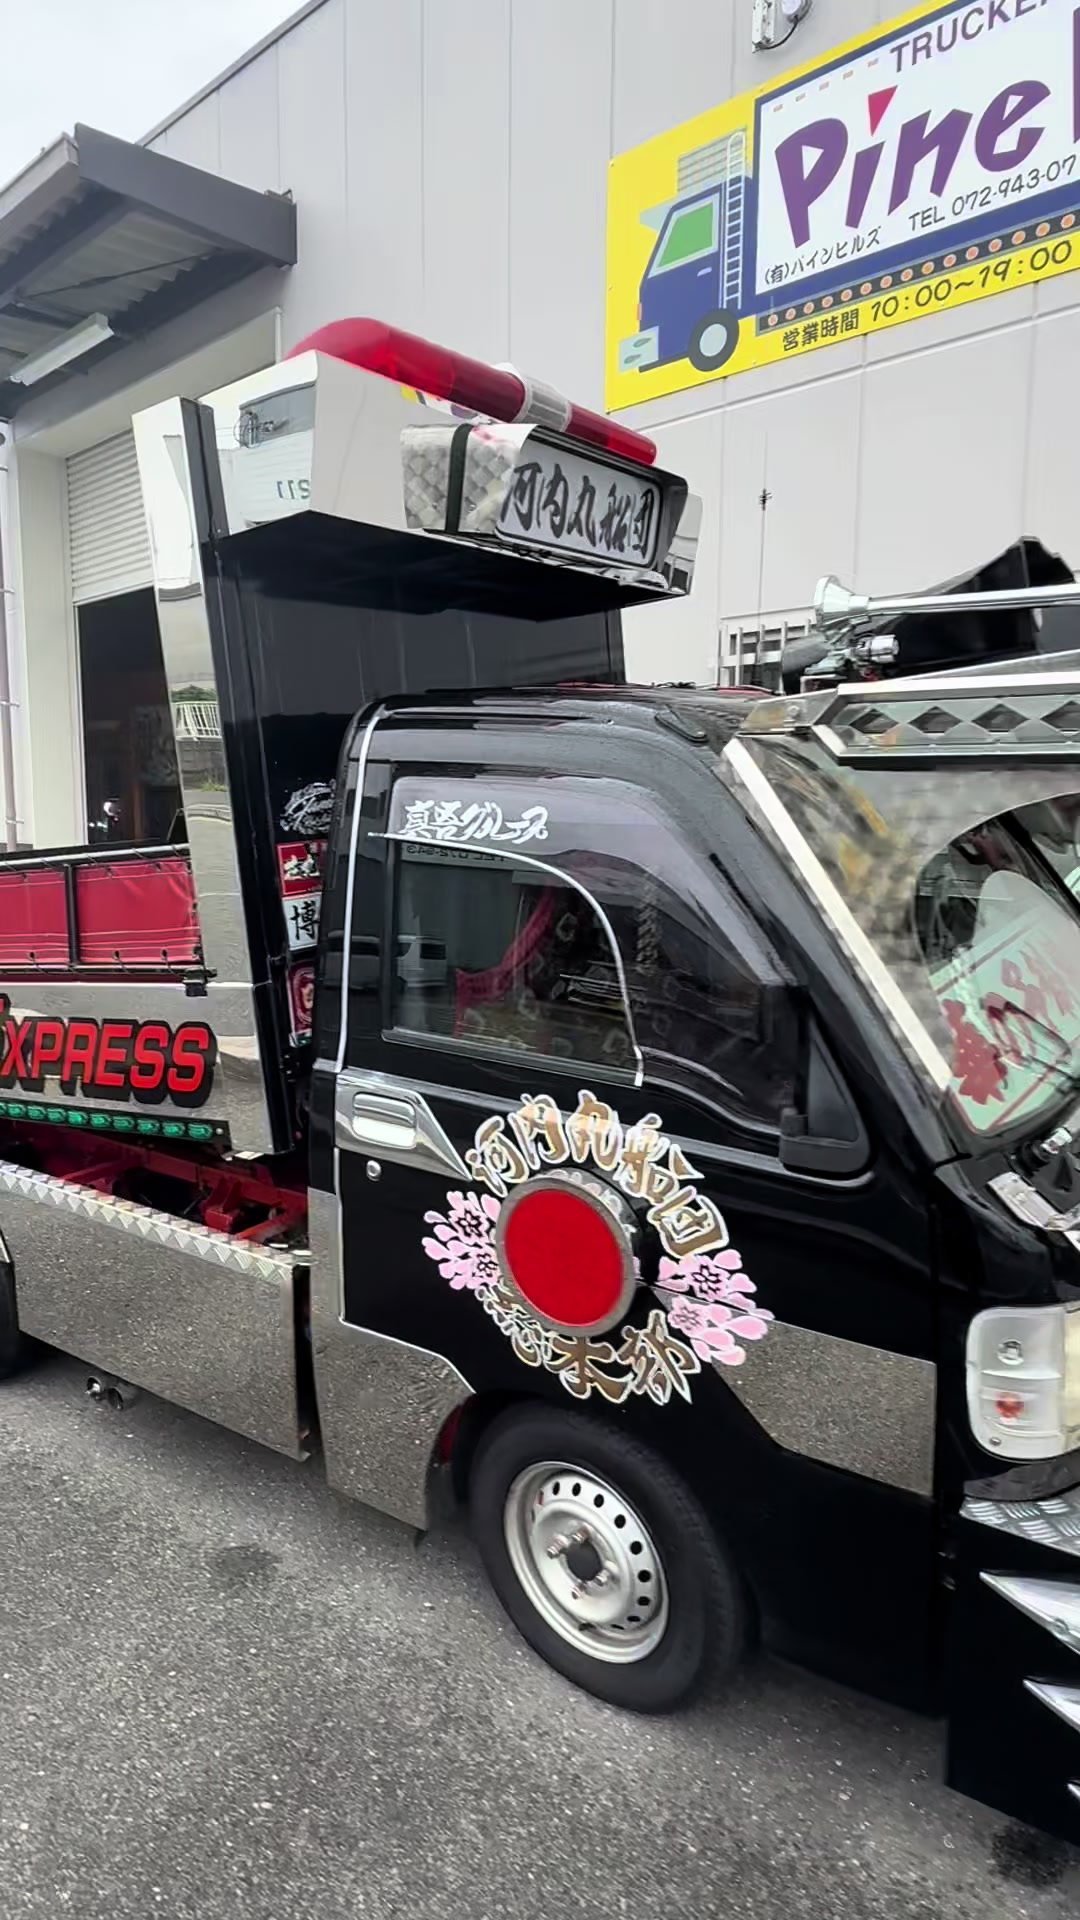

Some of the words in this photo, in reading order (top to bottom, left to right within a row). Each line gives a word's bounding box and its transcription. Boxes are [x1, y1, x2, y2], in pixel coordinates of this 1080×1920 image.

[890, 0, 1047, 73] TRUCKE
[775, 80, 1051, 249] Pine
[909, 206, 945, 232] TEL
[951, 155, 1077, 216] 072-943-07
[782, 308, 860, 351] 営業時間
[0, 1015, 211, 1095] XPRESS
